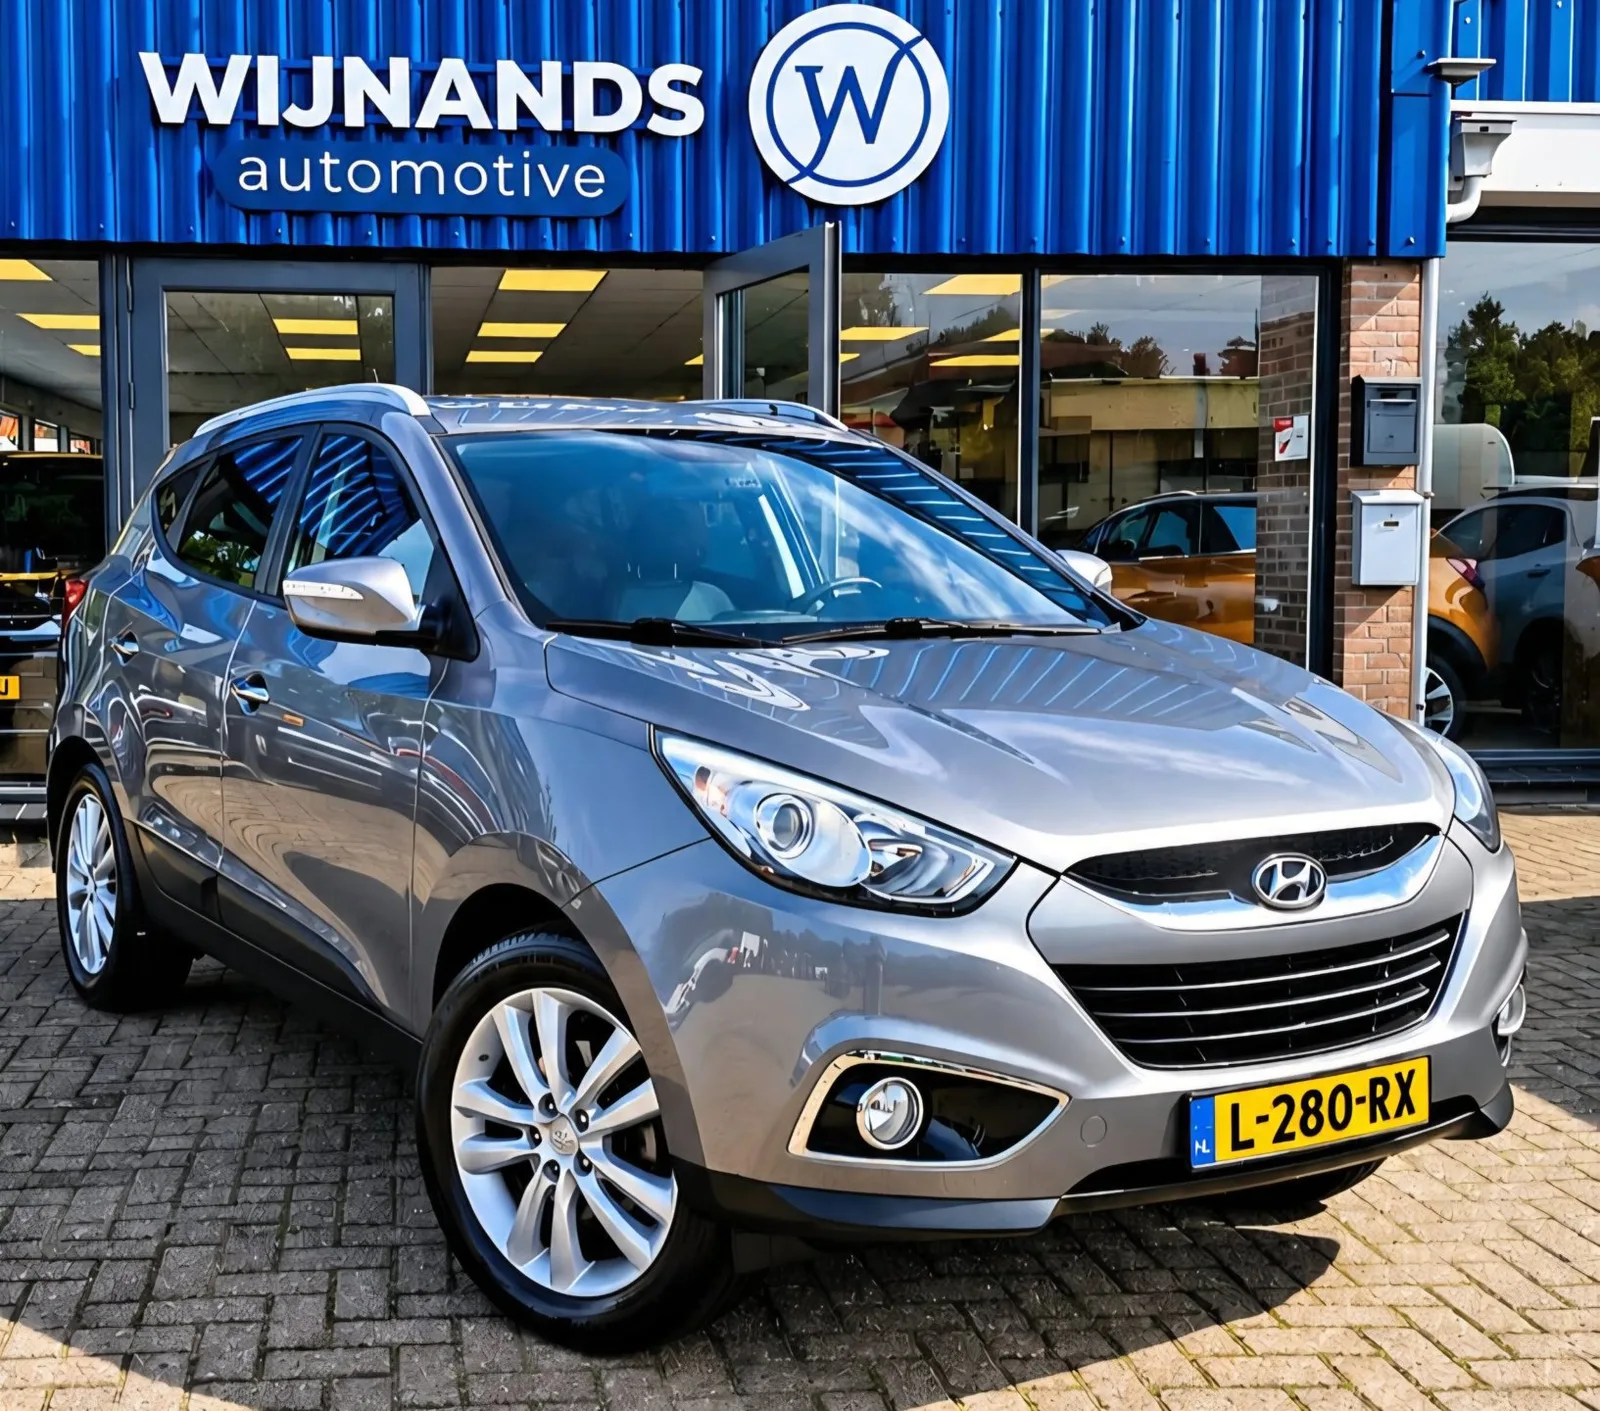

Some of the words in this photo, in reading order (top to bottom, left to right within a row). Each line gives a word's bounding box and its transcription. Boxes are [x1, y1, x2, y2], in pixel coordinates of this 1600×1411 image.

[138, 52, 705, 136] WIJNANDS
[238, 151, 605, 198] automotive
[1231, 1069, 1416, 1151] L-280-RX
[1195, 1138, 1210, 1156] NL
